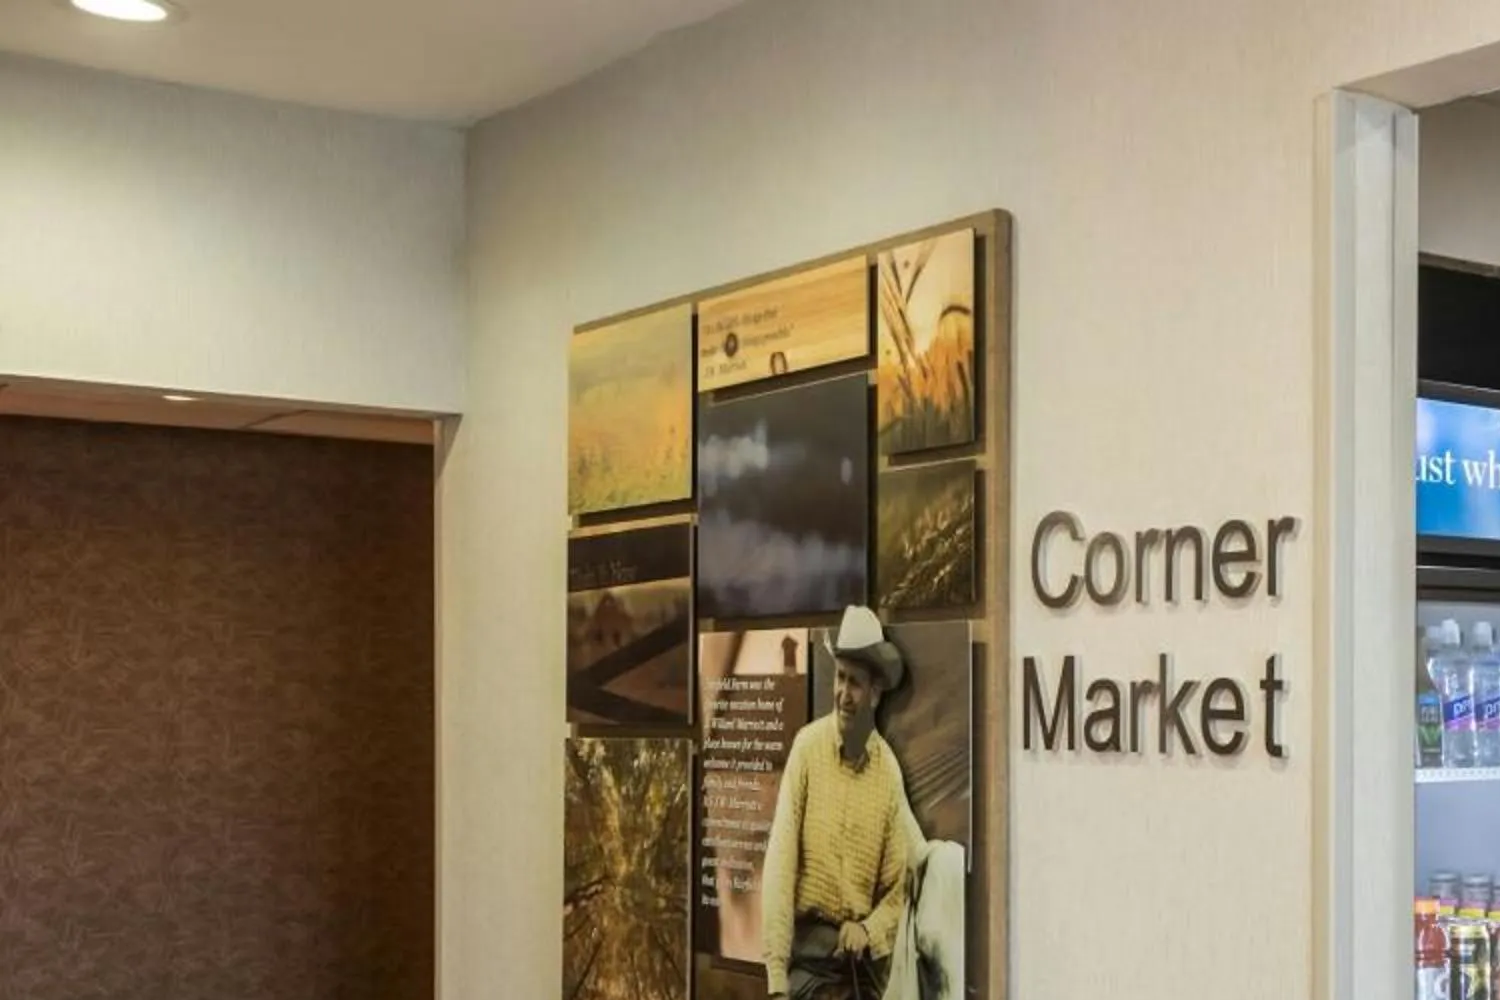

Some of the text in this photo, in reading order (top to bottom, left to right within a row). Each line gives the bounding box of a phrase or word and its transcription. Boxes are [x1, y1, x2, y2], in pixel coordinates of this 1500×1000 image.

[1416, 451, 1456, 485] ust
[1030, 510, 1298, 609] Corner
[1022, 652, 1286, 758] Market
